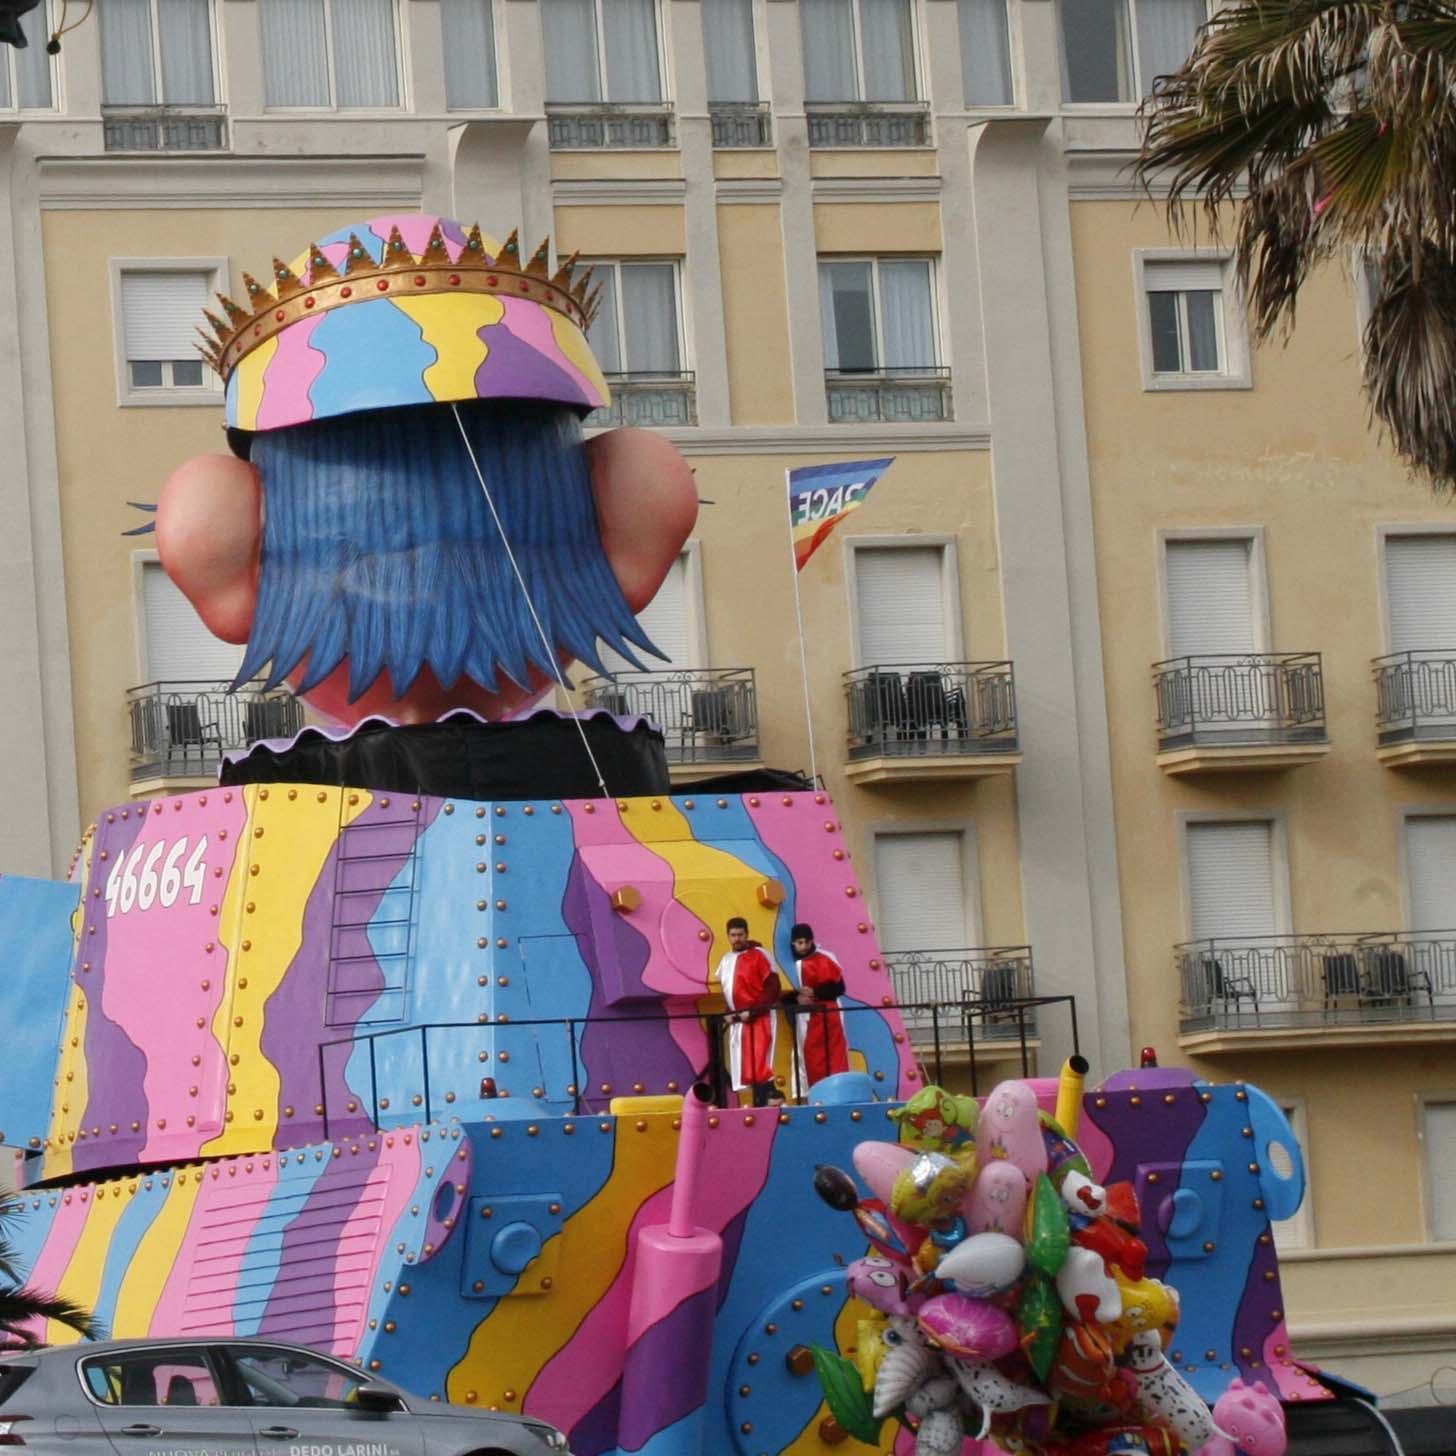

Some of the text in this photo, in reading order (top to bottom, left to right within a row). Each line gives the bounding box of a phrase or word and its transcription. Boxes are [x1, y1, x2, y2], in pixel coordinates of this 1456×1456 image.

[104, 835, 209, 918] 46664
[290, 1445, 333, 1456] DEDO
[337, 1444, 388, 1456] LARINI
